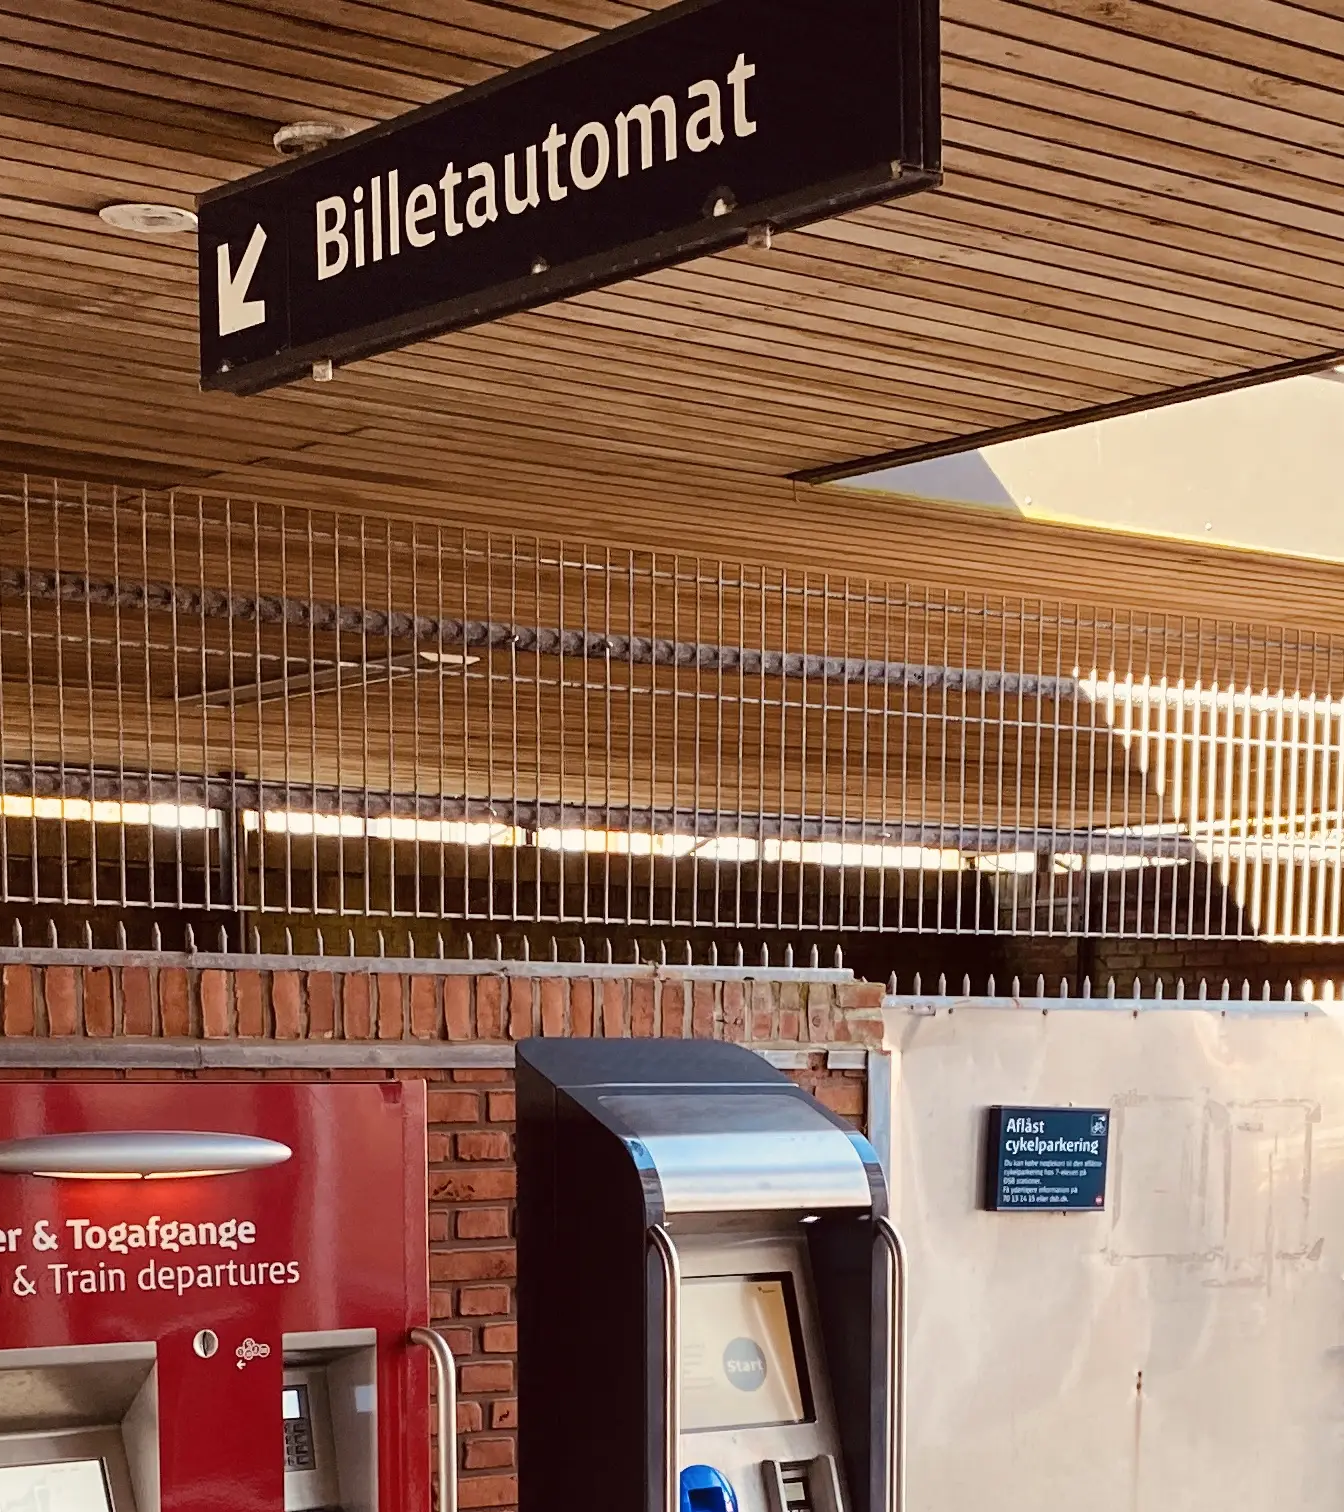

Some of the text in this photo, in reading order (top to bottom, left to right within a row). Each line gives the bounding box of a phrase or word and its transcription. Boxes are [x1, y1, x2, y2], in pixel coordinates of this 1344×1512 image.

[316, 52, 757, 281] Billetautomat
[1006, 1117, 1045, 1134] Aflåst
[1005, 1137, 1099, 1155] cykelparkering
[32, 1219, 58, 1250] &
[66, 1216, 256, 1254] Togafgange
[12, 1265, 37, 1296] &
[48, 1261, 126, 1294] Train
[137, 1260, 300, 1296] departures
[727, 1356, 764, 1373] Start
